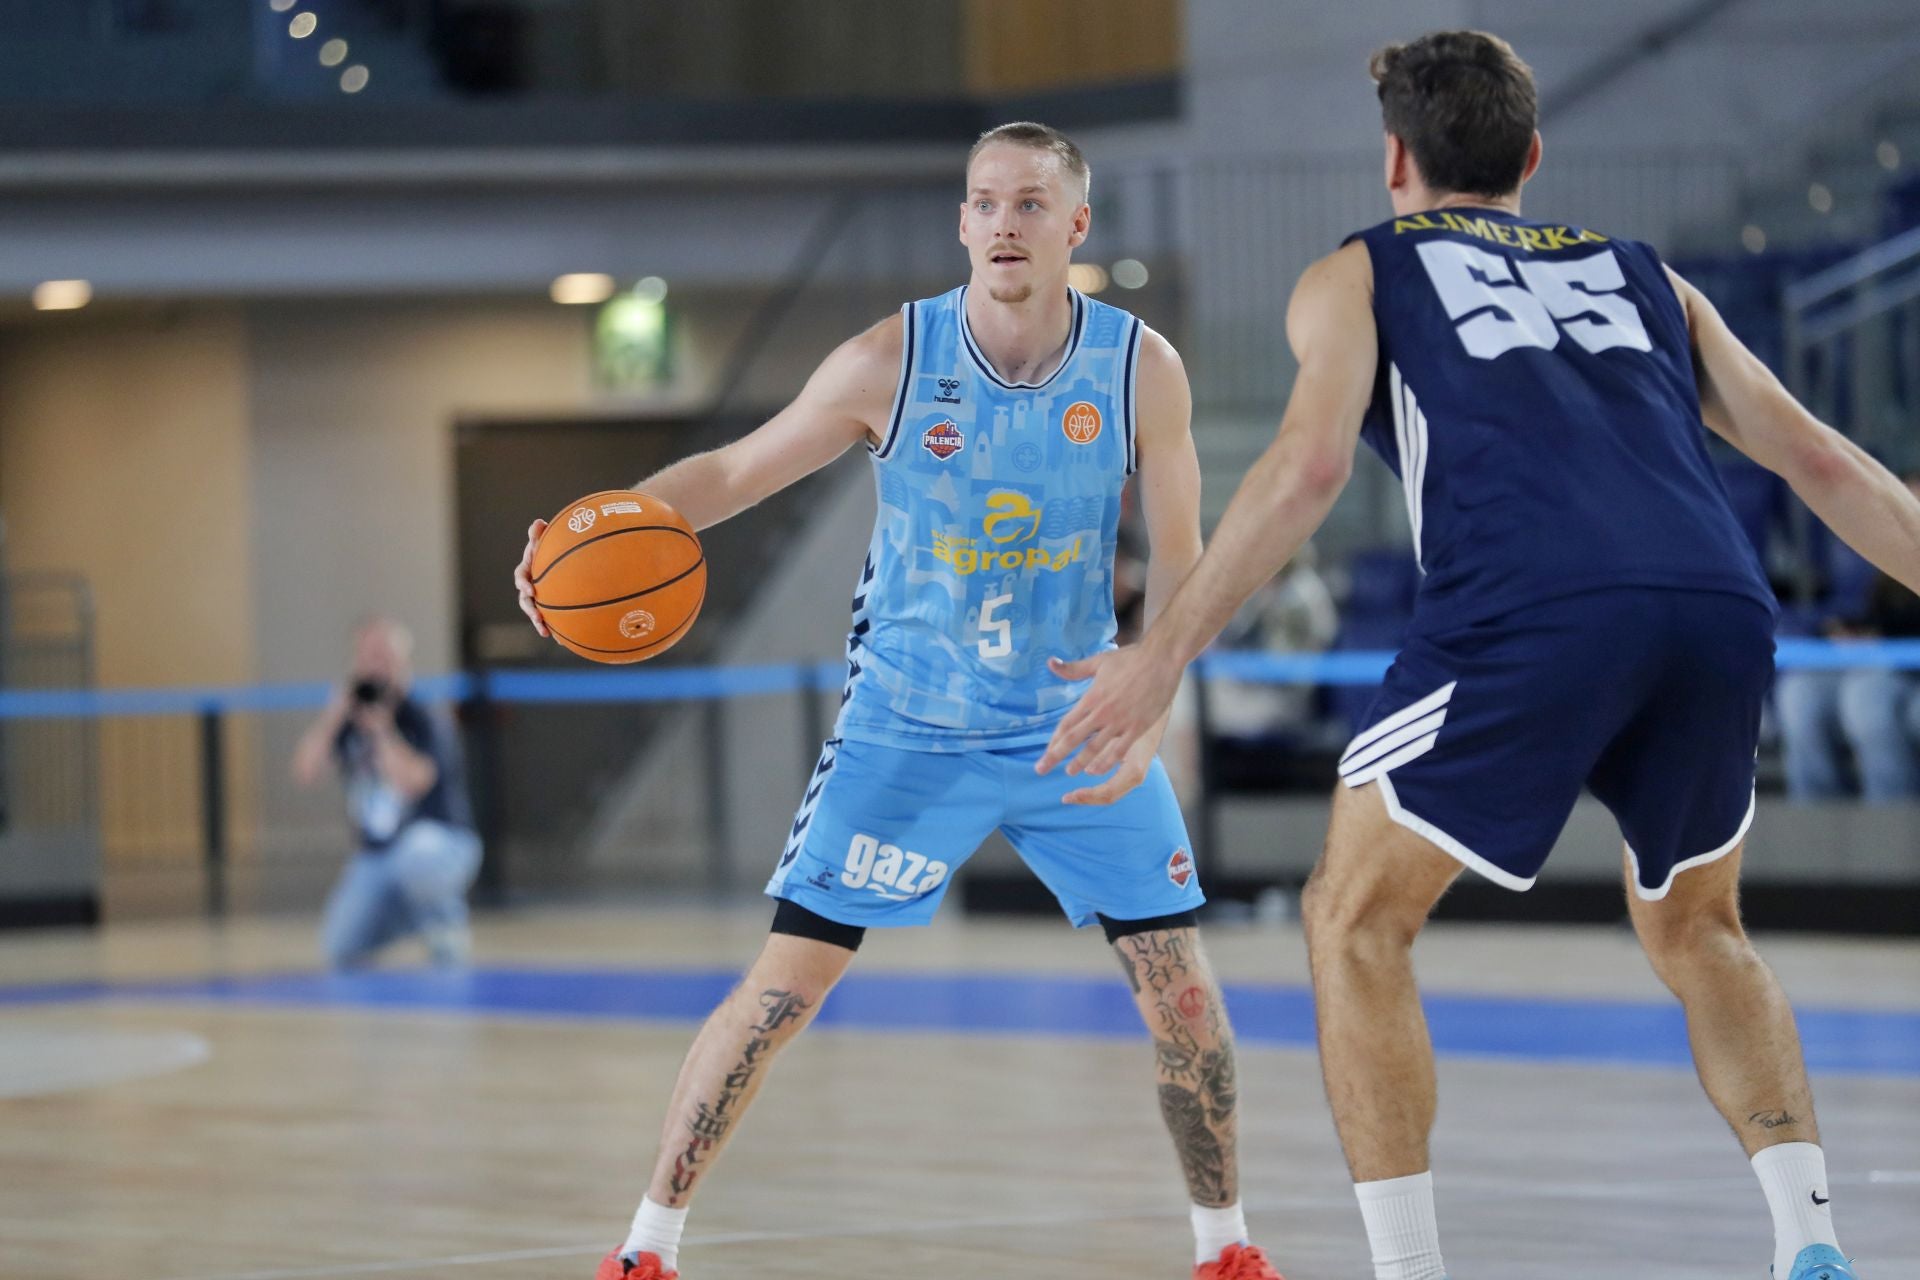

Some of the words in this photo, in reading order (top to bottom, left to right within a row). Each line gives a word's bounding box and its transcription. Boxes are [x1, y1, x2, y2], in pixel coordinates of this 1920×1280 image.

[1394, 212, 1610, 251] ALIMERKA
[1415, 240, 1653, 360] 55
[925, 435, 961, 447] PALENCIA
[977, 593, 1014, 659] 5
[840, 832, 949, 895] gaza
